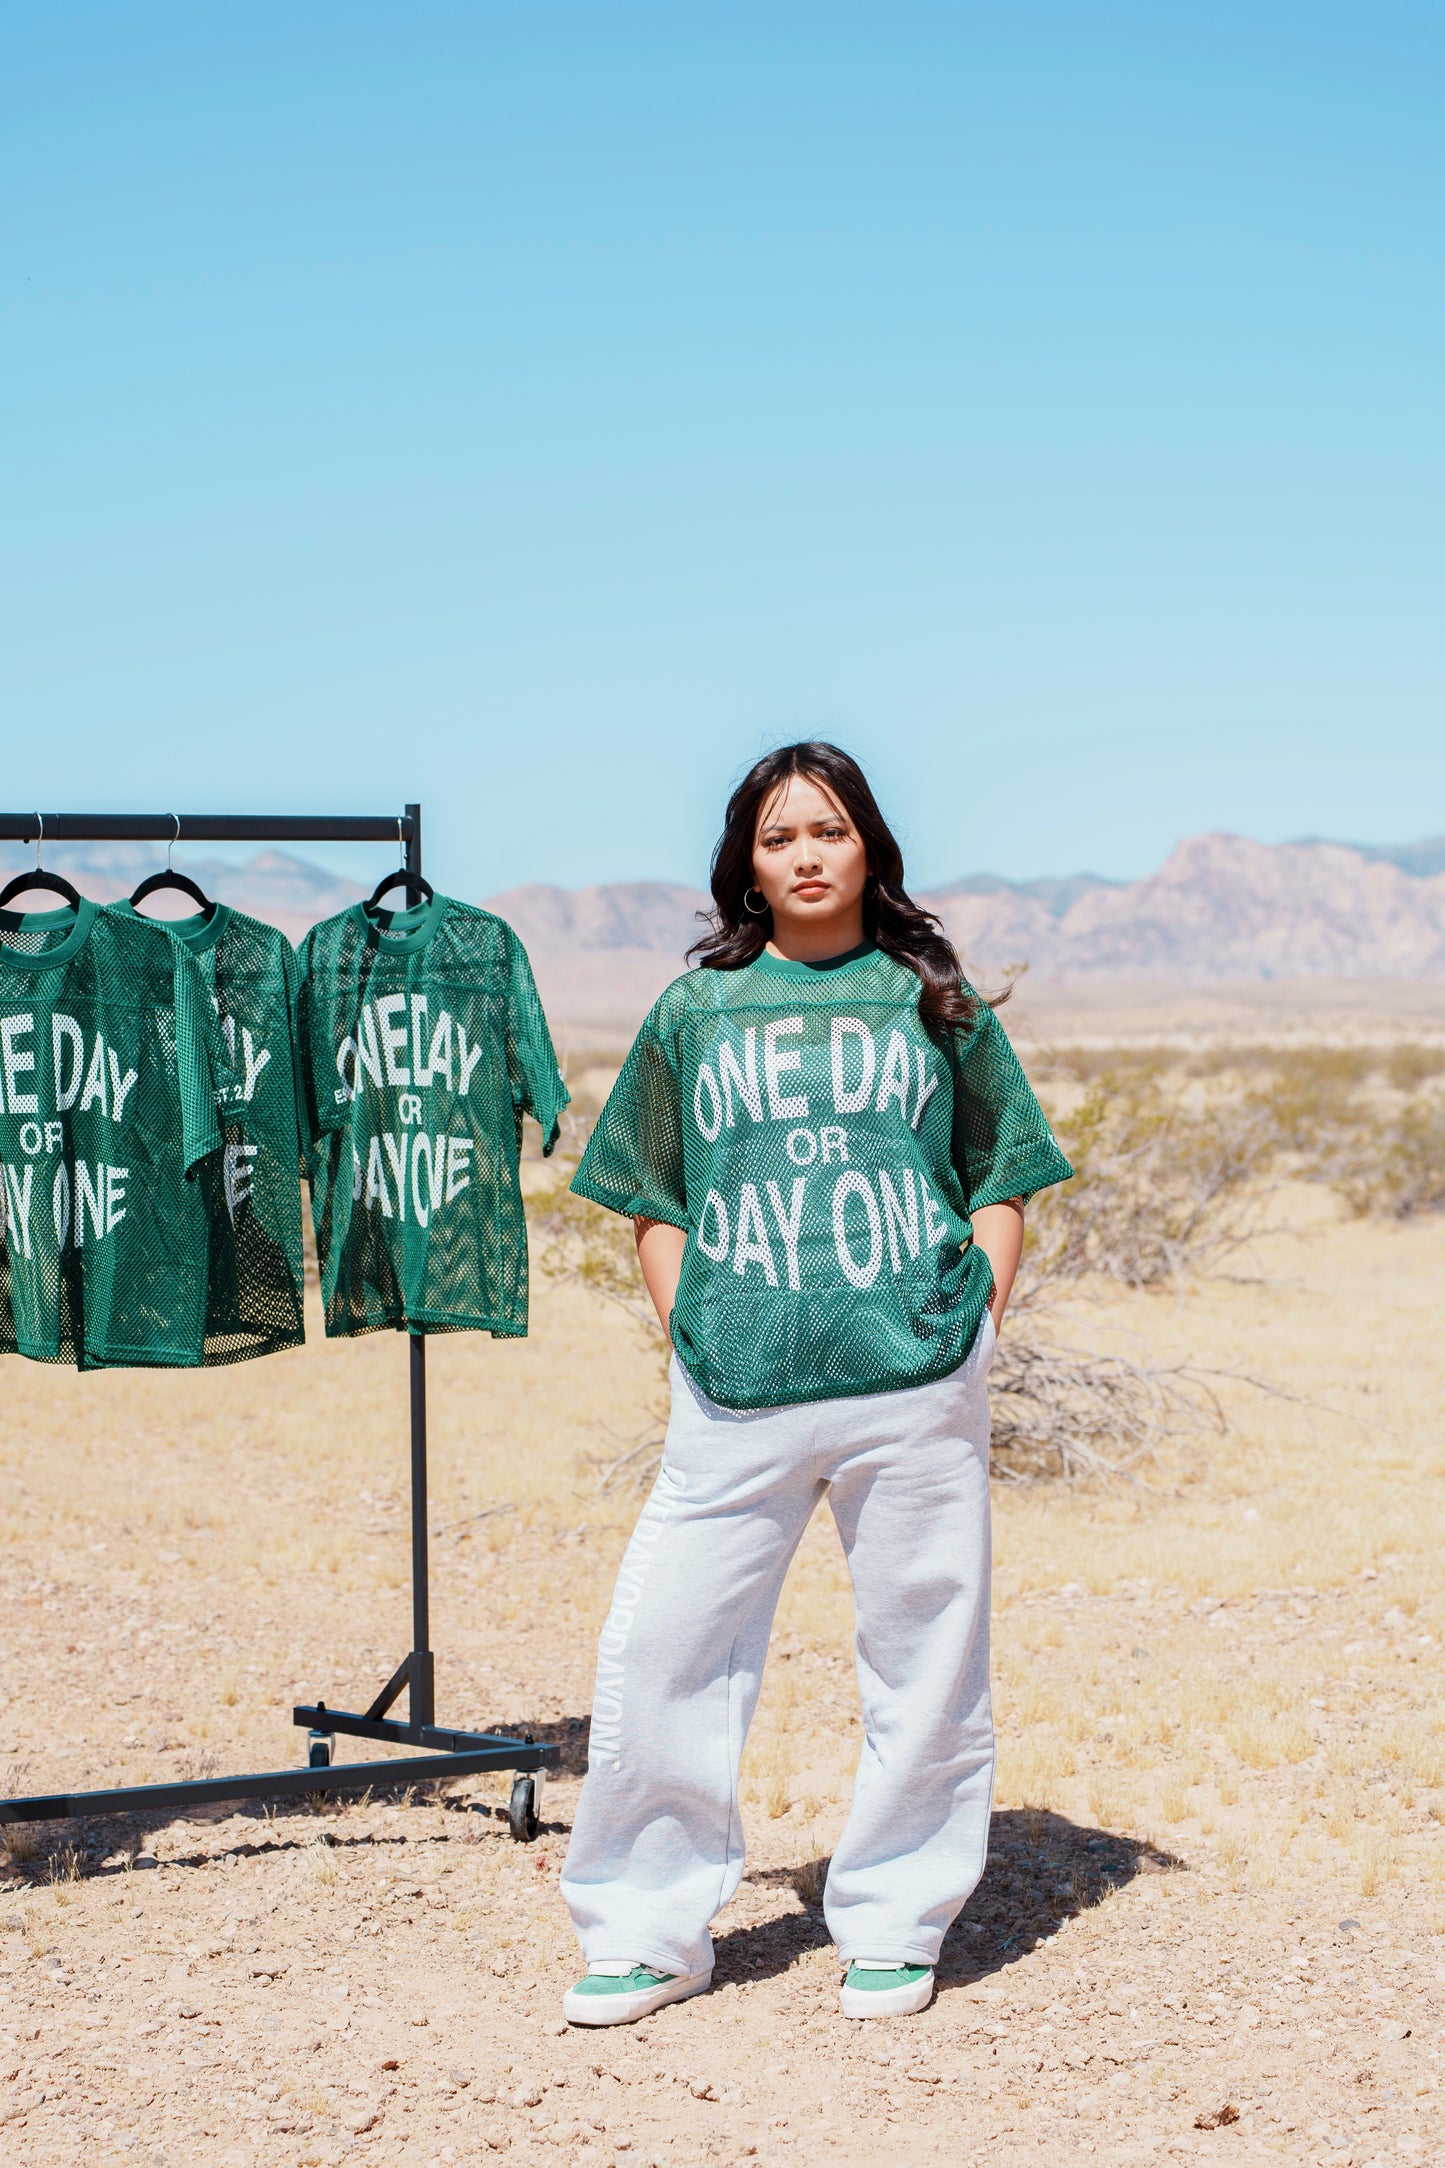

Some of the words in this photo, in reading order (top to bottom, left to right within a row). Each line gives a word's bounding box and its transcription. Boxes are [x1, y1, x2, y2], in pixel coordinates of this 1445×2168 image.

[52, 1013, 138, 1122] DAY
[398, 1094, 422, 1125] OR
[694, 1017, 809, 1142] ONE
[831, 1017, 939, 1131] DAY
[19, 1121, 63, 1155] OR
[786, 1125, 850, 1166] OR
[53, 1159, 129, 1251] ONE
[698, 1177, 807, 1291] DAY
[832, 1169, 949, 1289] ONE
